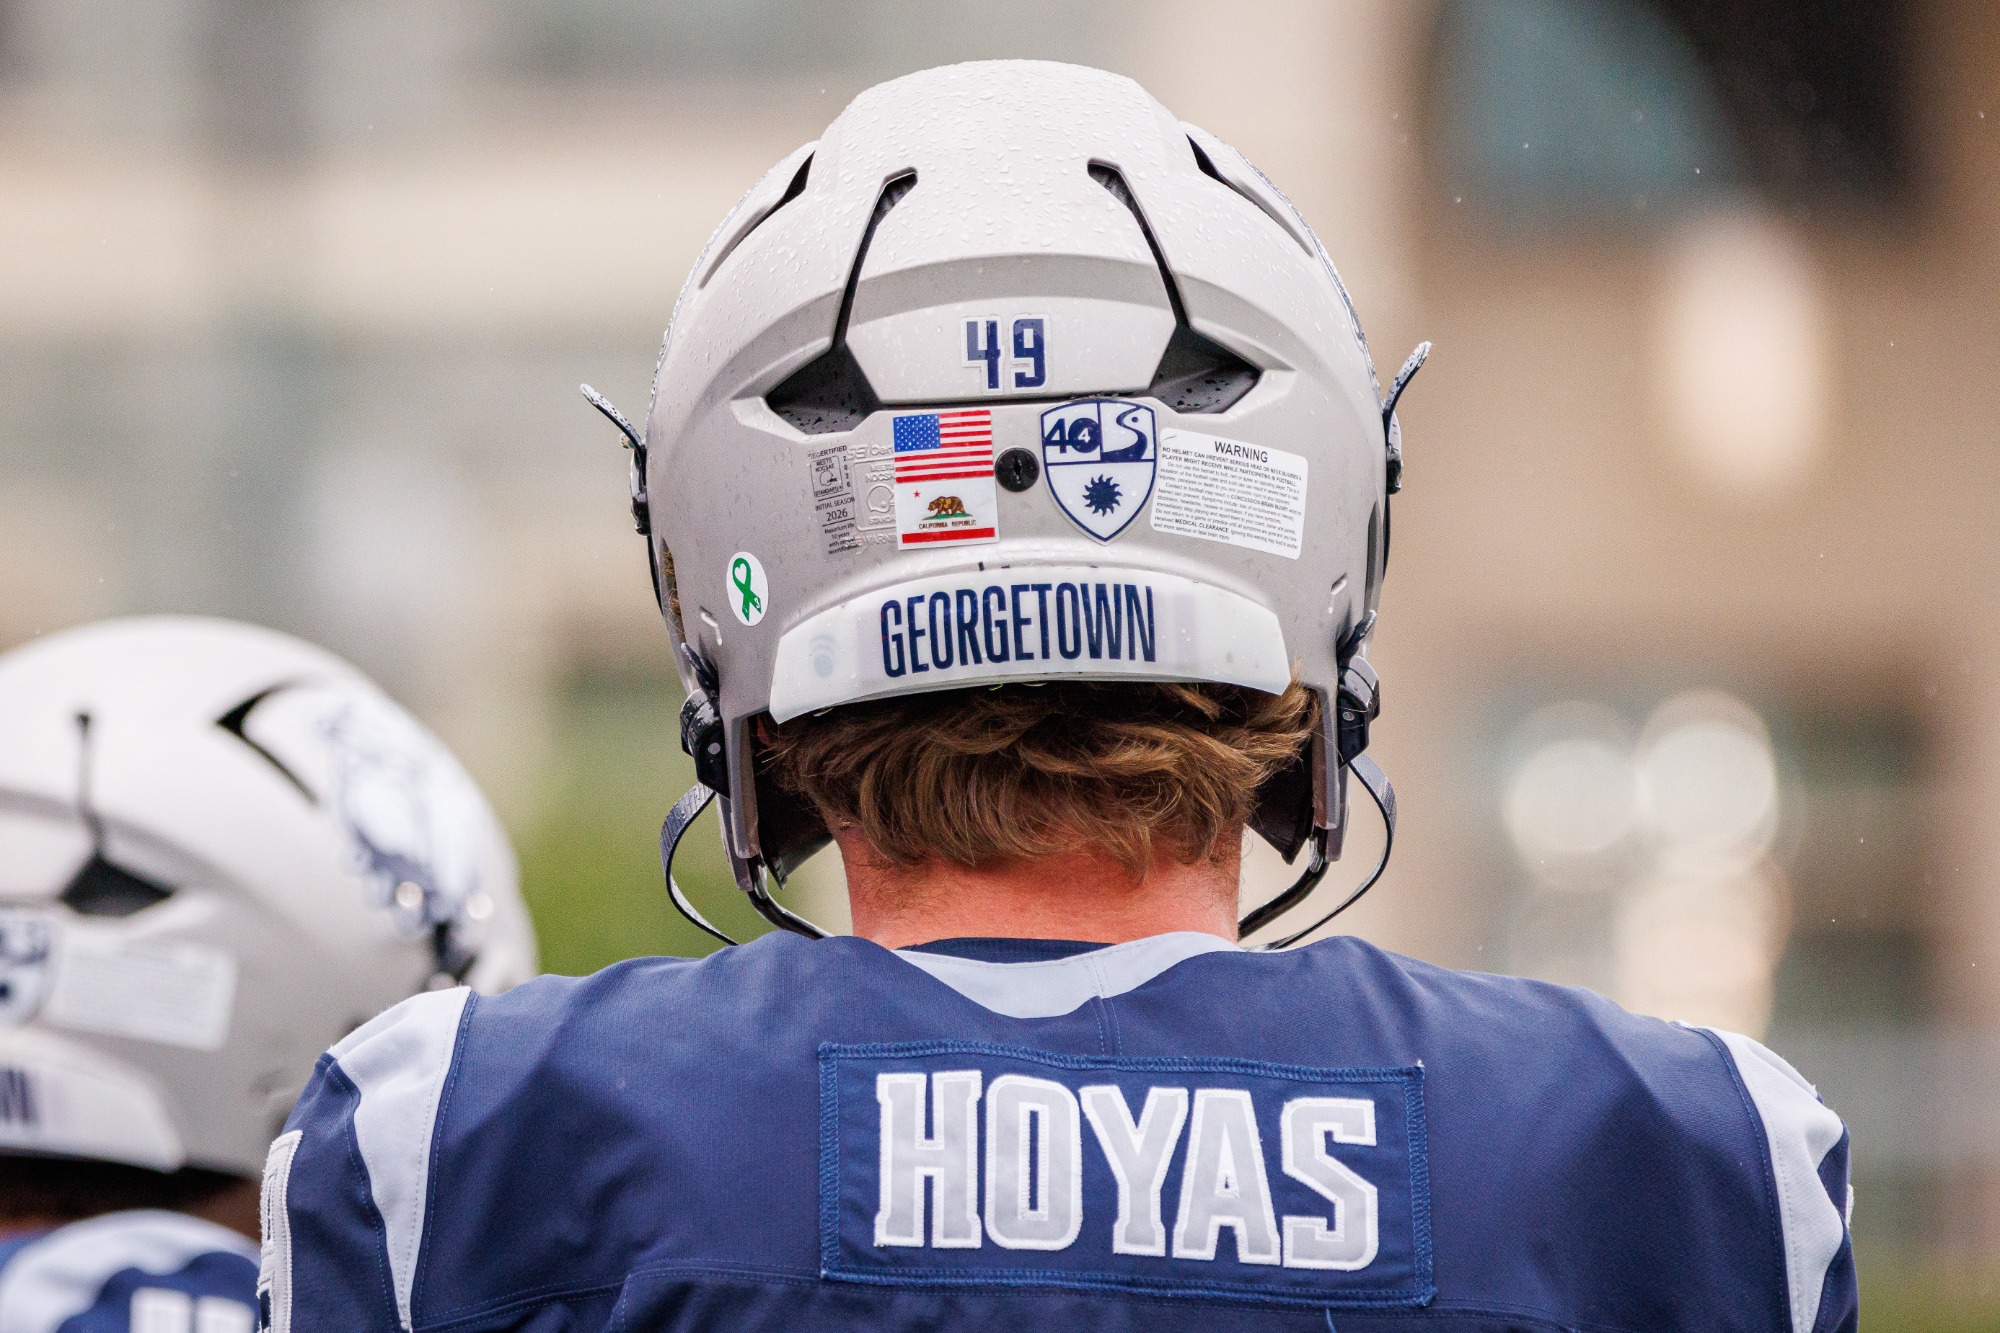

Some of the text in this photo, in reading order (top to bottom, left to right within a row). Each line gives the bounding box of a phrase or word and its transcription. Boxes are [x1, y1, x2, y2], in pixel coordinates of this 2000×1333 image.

[964, 317, 1048, 391] 49
[1171, 448, 1192, 456] HELMET
[1229, 459, 1249, 467] SERIOUS
[1214, 440, 1268, 463] WARNING
[1161, 453, 1182, 461] PLAYER
[1201, 460, 1222, 468] RECEIVE
[1239, 468, 1270, 479] PARTICIPATING
[815, 496, 855, 511] INITIAL SEASON
[1193, 507, 1209, 515] playing
[826, 508, 848, 521] 2026
[1174, 518, 1197, 526] MEDICAL
[824, 524, 847, 534] Maximum
[918, 519, 977, 529] CALIFORNIA REPUBLIC
[881, 582, 1156, 679] GEORGETOWN
[874, 1069, 1380, 1272] HOYAS
